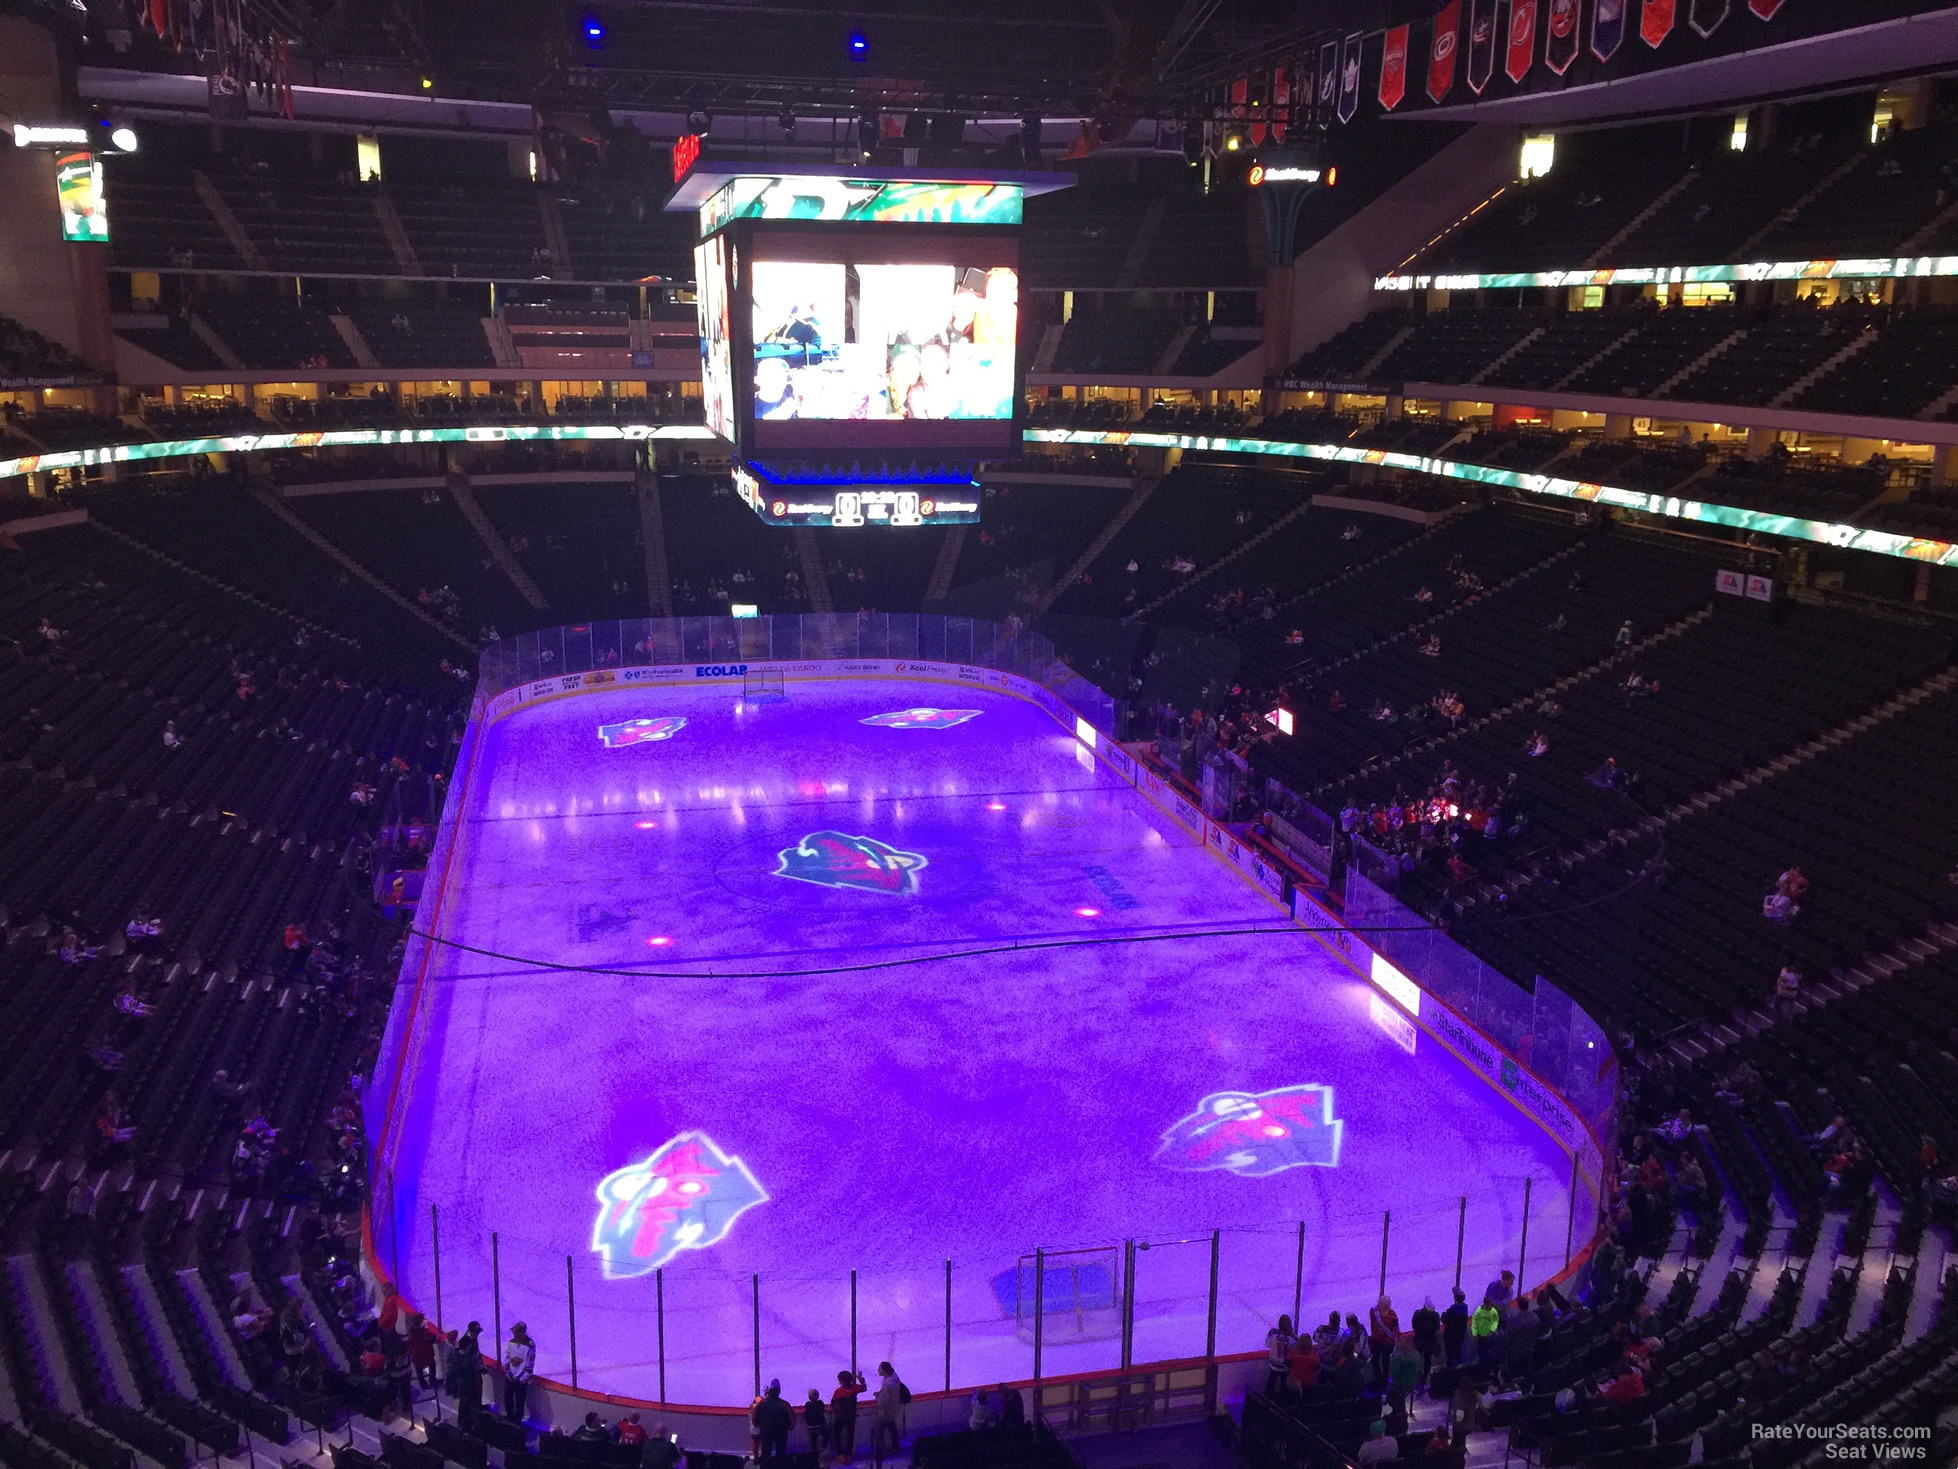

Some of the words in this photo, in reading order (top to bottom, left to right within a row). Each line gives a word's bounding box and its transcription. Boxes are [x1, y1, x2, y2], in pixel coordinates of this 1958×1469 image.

[1300, 380, 1324, 390] Wealth
[1325, 381, 1368, 392] Management
[696, 665, 748, 677] ECOLAB
[561, 675, 581, 683] FRESH
[564, 682, 579, 690] FAST
